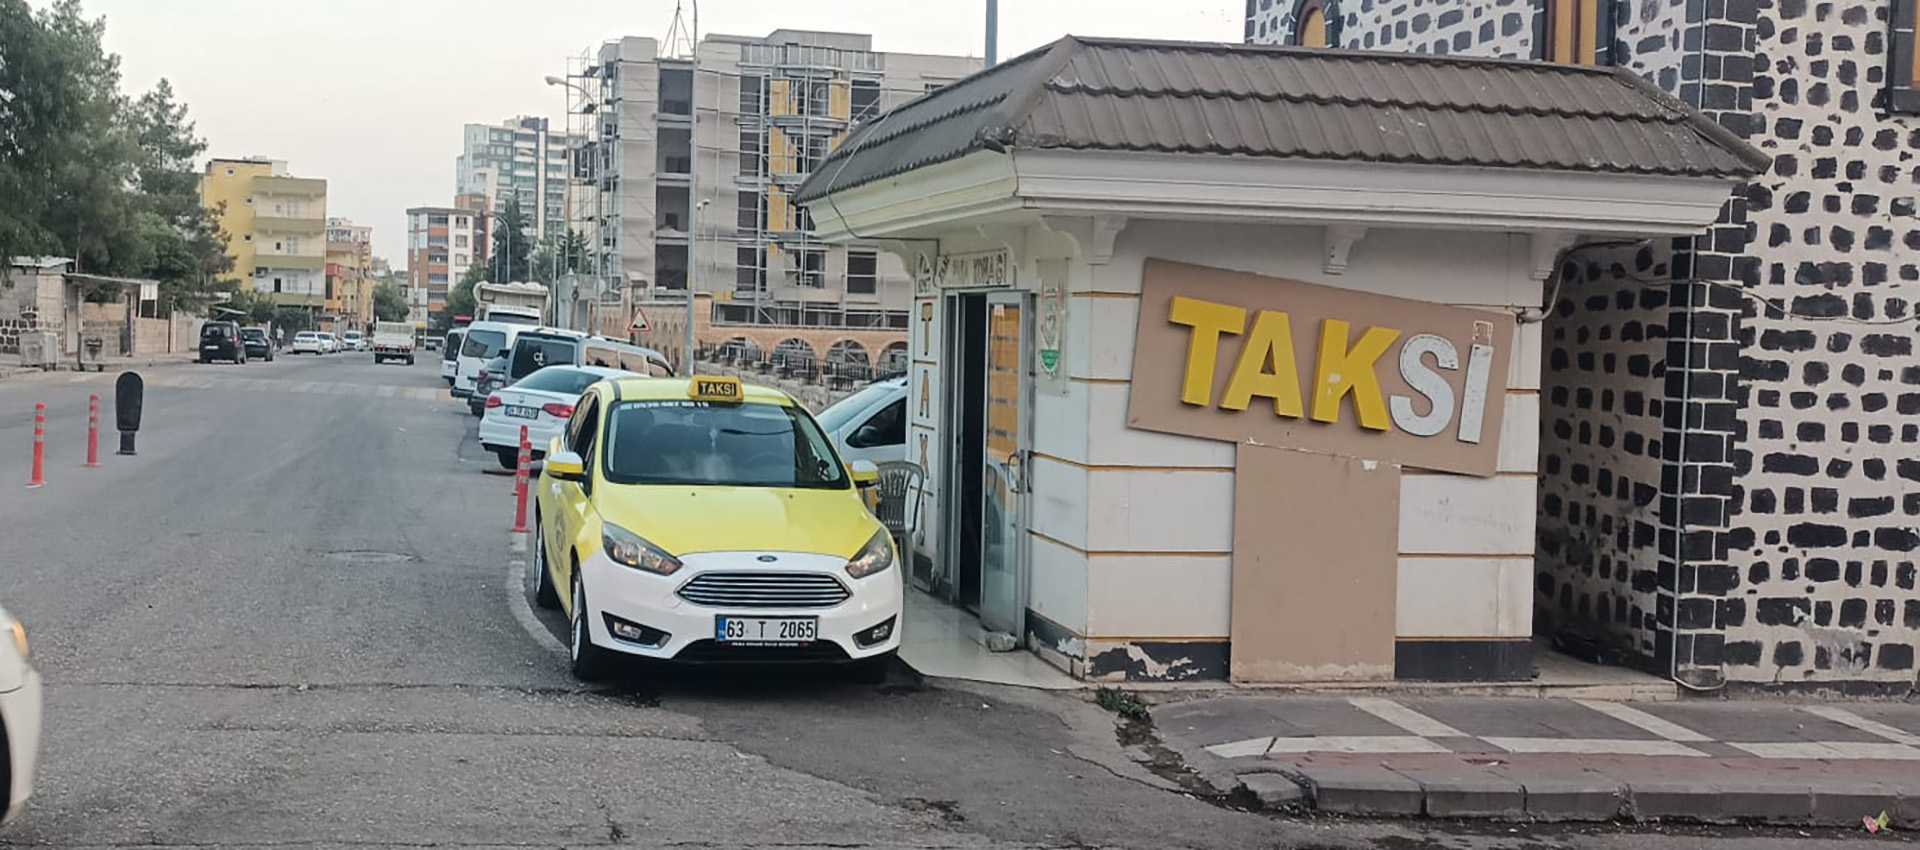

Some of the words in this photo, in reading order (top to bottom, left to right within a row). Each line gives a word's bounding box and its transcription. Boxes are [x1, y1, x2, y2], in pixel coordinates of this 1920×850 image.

[1168, 295, 1494, 444] TAKSİ
[726, 620, 744, 638] 63
[758, 620, 767, 638] T
[780, 621, 814, 638] 2065
